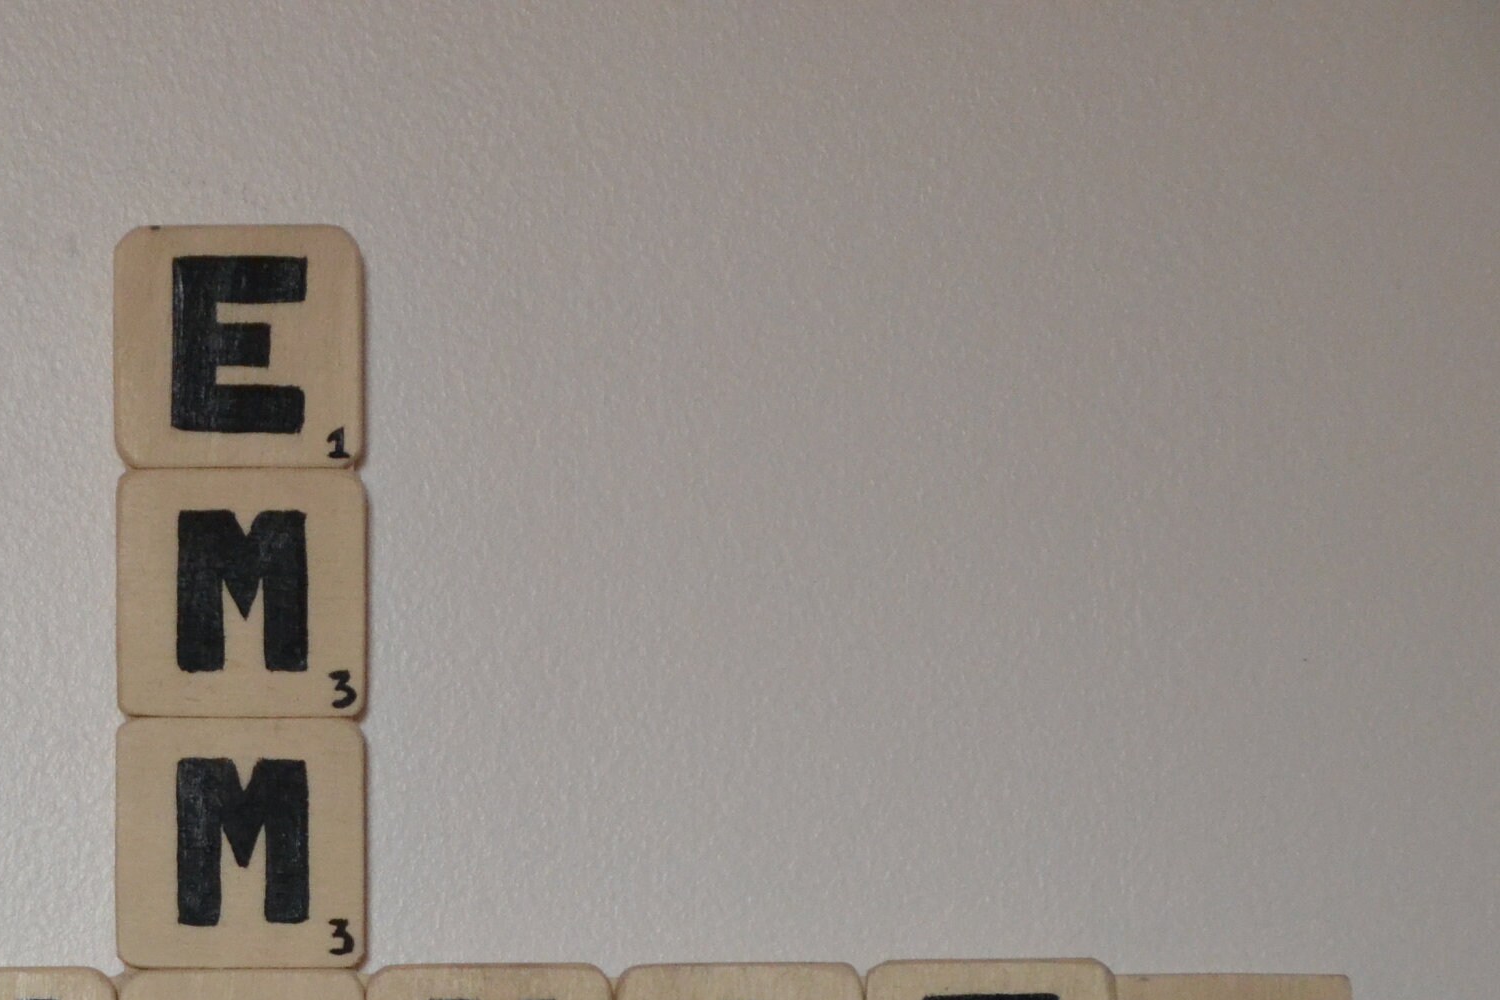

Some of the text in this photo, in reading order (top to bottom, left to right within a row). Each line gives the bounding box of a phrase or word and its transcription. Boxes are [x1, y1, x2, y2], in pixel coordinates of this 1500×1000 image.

[327, 428, 351, 460] 1
[328, 669, 358, 709] 3
[328, 918, 356, 956] 3
